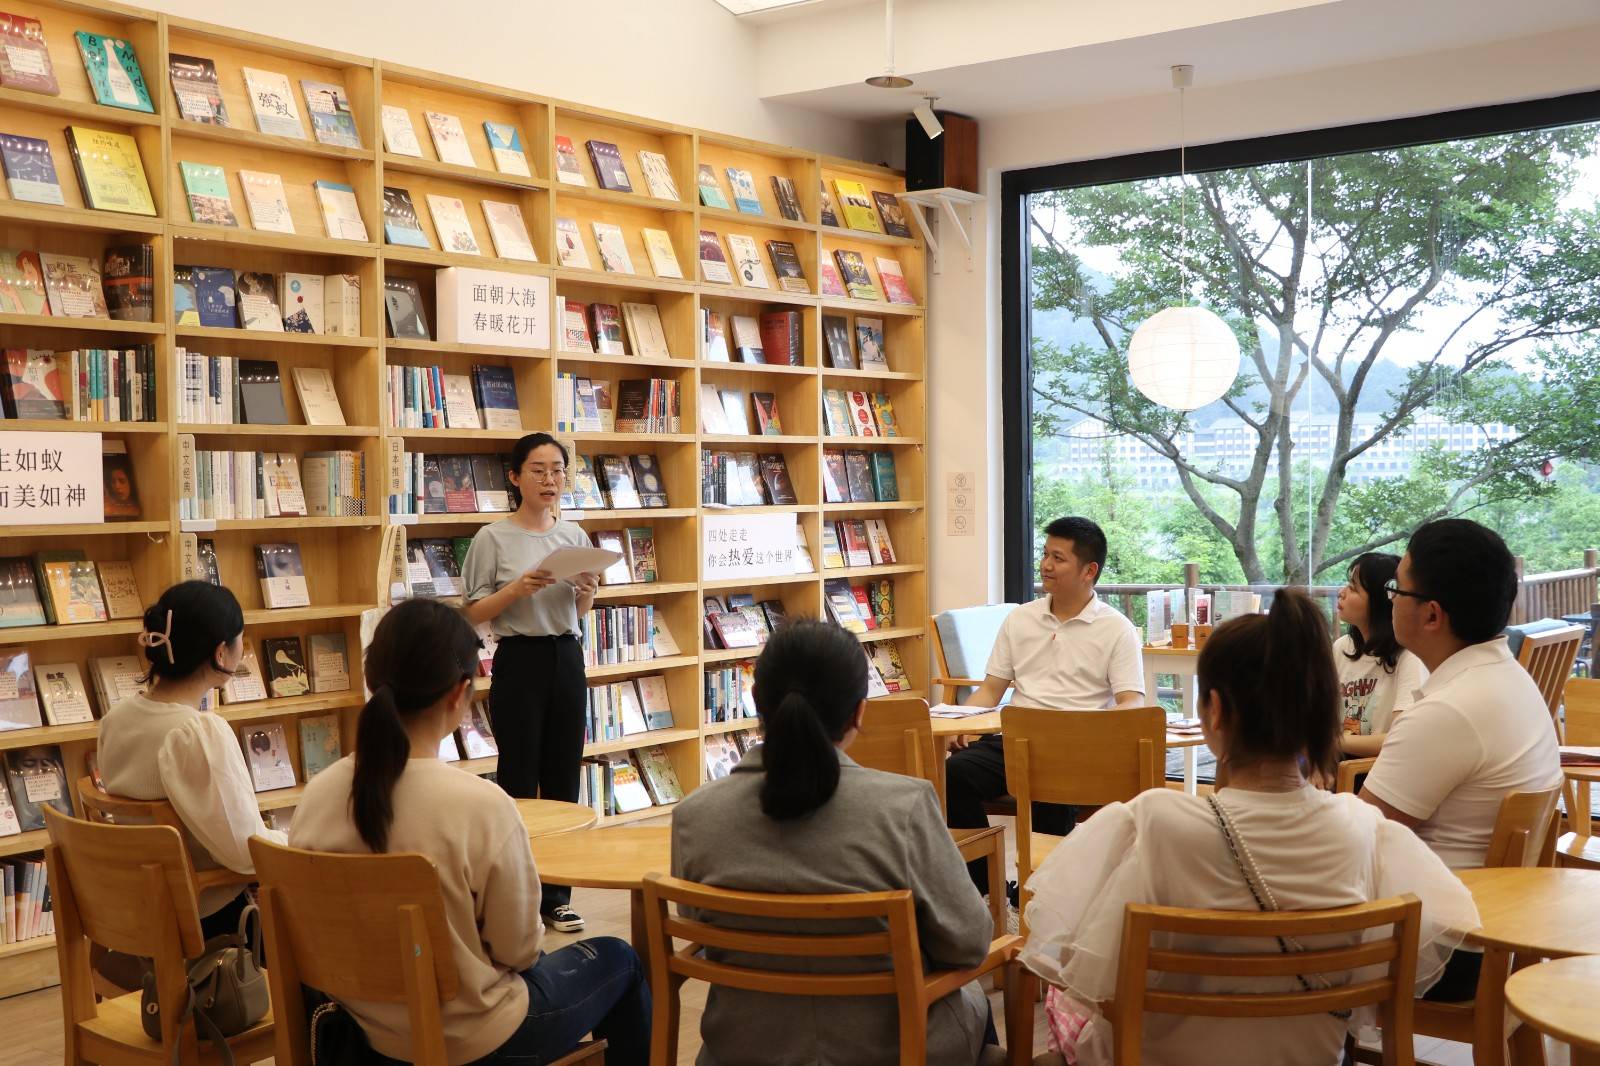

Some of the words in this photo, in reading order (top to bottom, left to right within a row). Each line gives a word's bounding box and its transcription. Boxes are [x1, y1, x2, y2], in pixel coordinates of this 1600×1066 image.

[472, 284, 536, 307] 面朝大海
[472, 311, 537, 335] 春暖花开
[708, 528, 748, 543] 四处走走
[708, 547, 793, 568] 你会热爱这个世界
